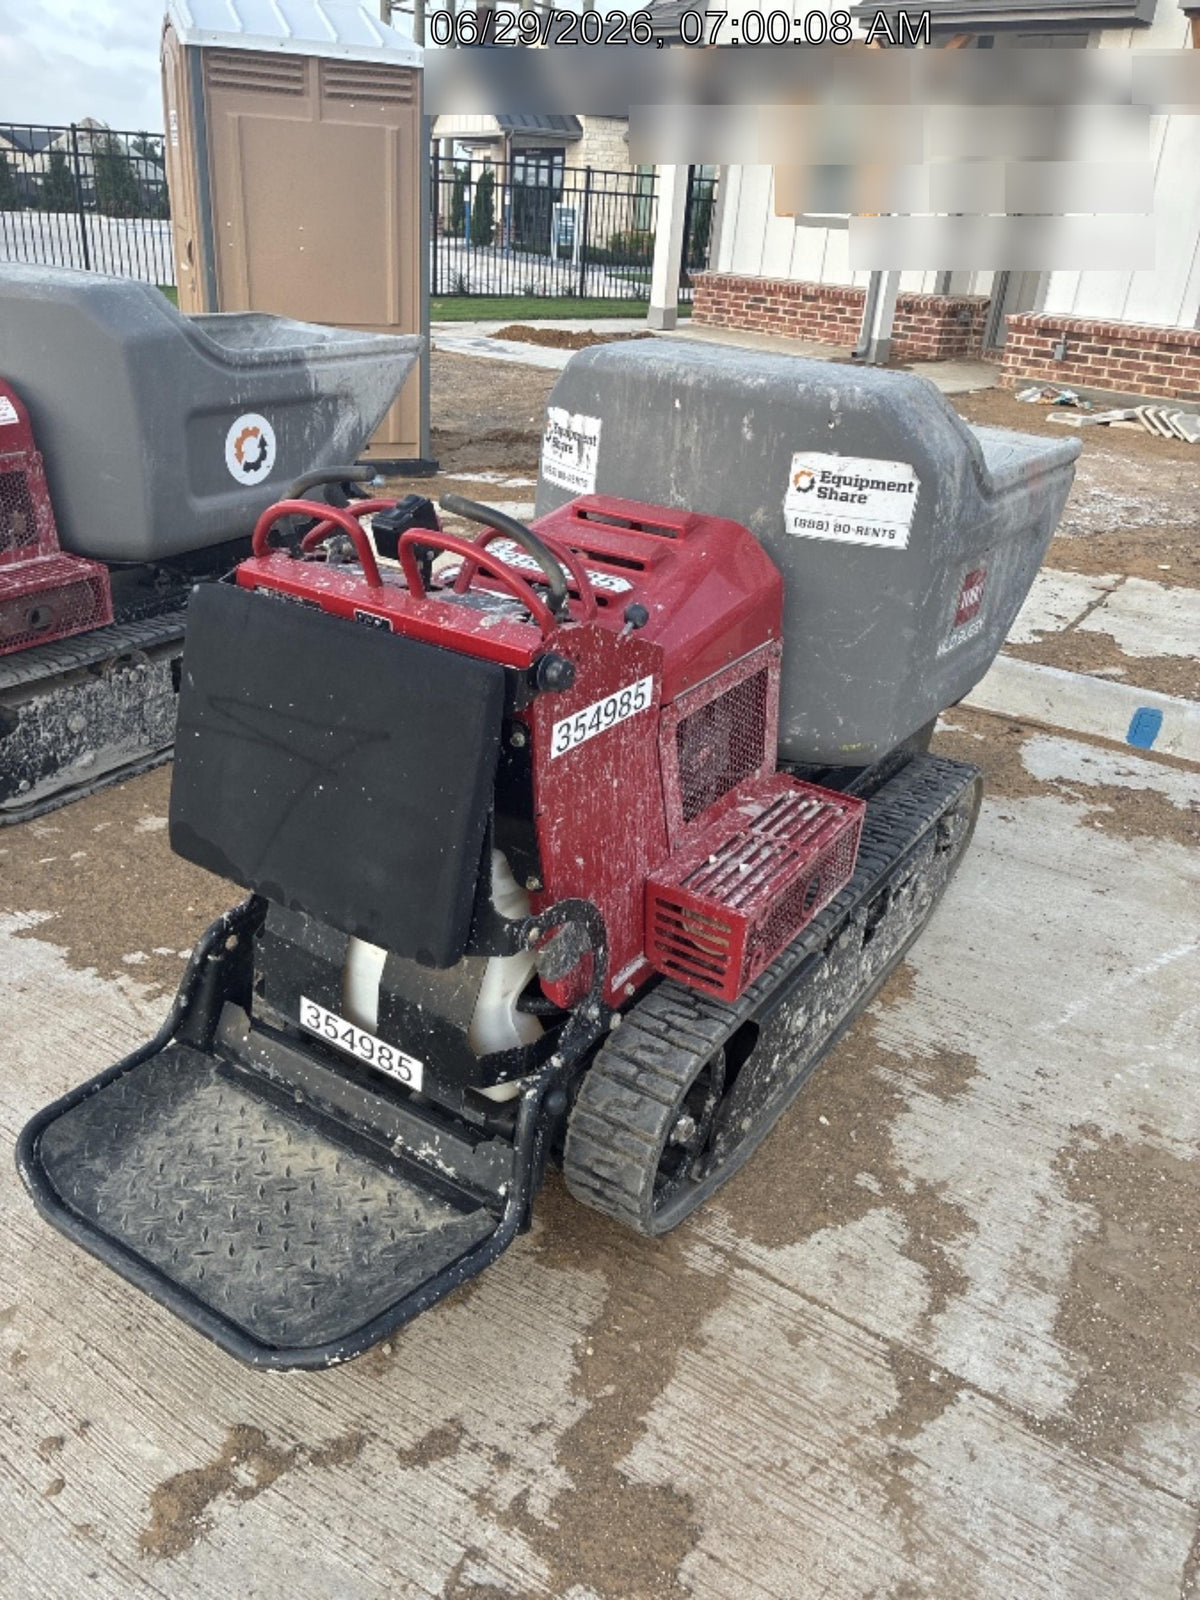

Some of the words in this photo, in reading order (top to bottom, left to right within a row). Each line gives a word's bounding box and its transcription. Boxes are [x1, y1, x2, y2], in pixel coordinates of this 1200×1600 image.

[819, 470, 915, 493] Equipment
[817, 486, 868, 504] Share
[793, 516, 829, 532] (888)
[833, 522, 897, 540] 80-RENTS
[556, 682, 646, 752] 354985
[306, 1004, 412, 1082] 354985
